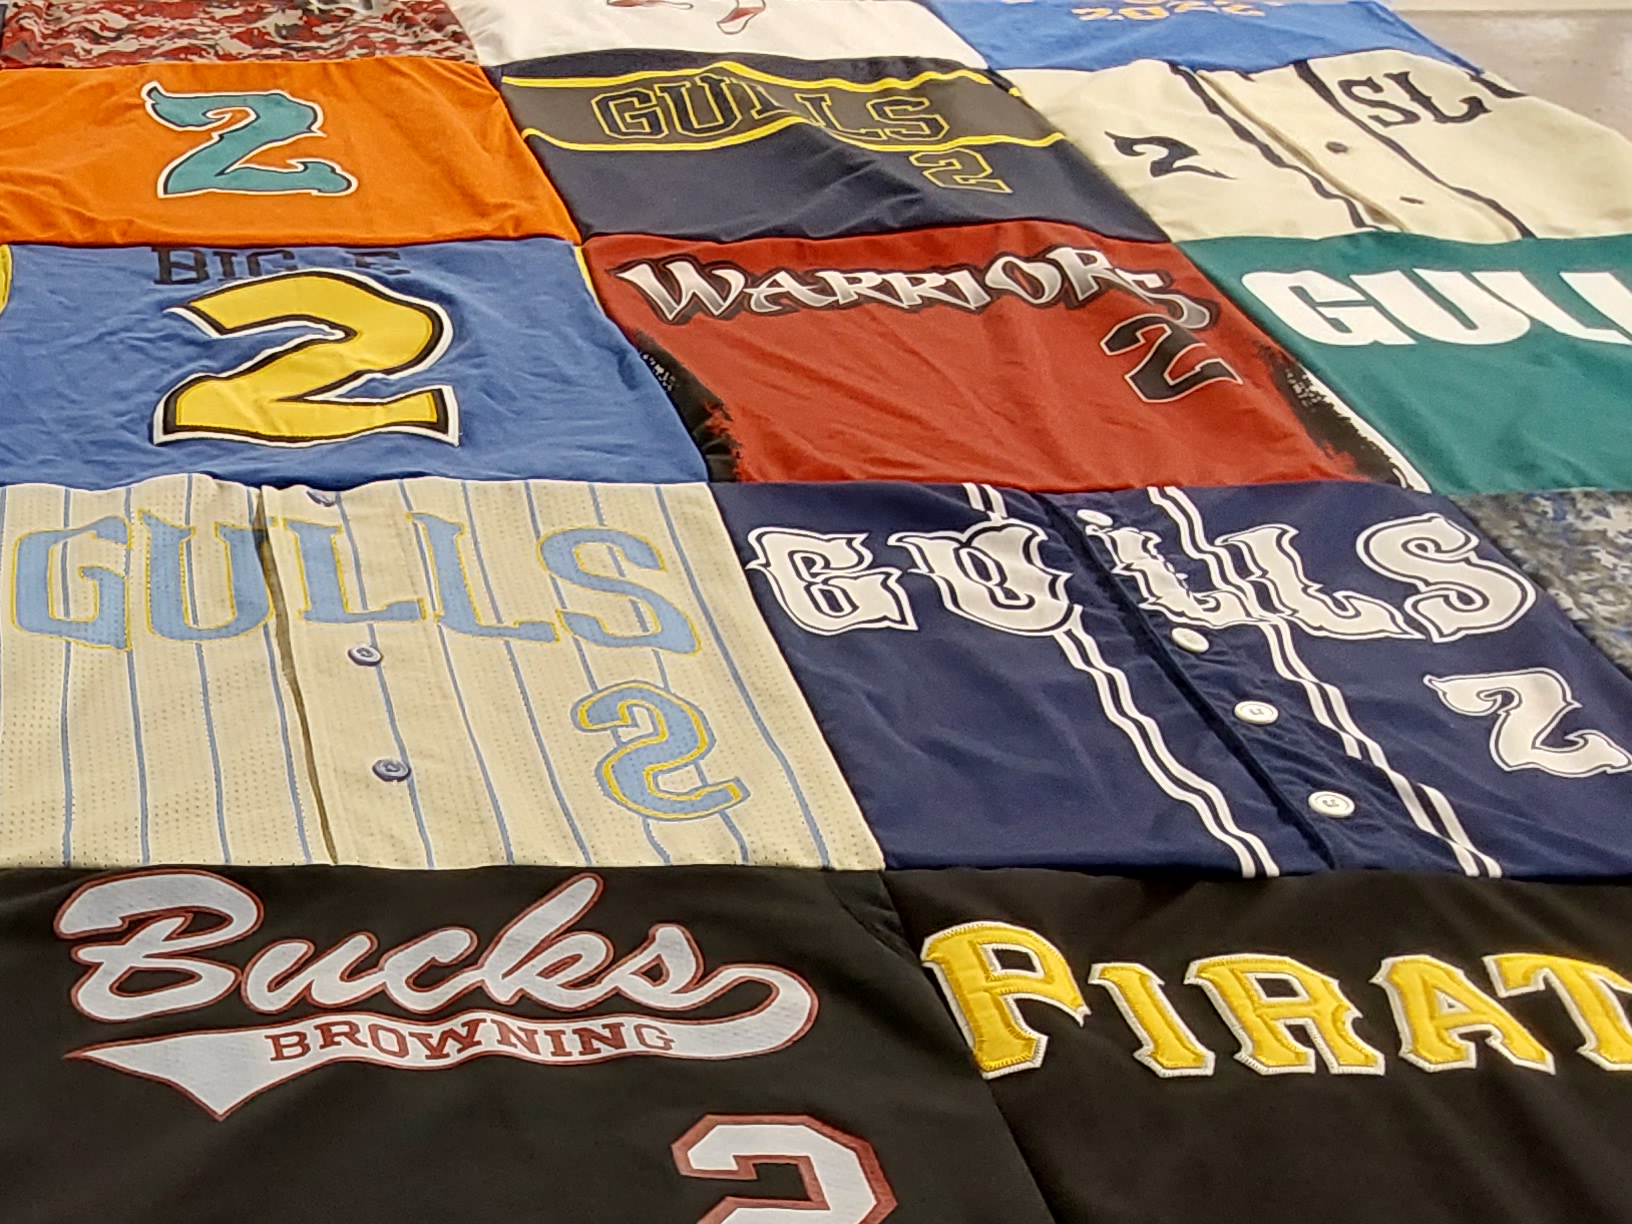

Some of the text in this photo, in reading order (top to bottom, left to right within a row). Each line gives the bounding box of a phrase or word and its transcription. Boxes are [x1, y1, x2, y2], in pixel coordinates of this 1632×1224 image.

[139, 81, 359, 198] 2
[1103, 129, 1238, 180] 2
[1337, 70, 1493, 128] SL
[909, 148, 1014, 194] 2
[152, 268, 460, 447] 2
[1100, 313, 1244, 403] 2
[10, 510, 704, 656] GULLS
[745, 511, 1538, 643] GULLS
[570, 679, 751, 823] 2
[1423, 666, 1632, 777] 2
[53, 868, 818, 1022] Bucks
[265, 1020, 677, 1064] BROWNING
